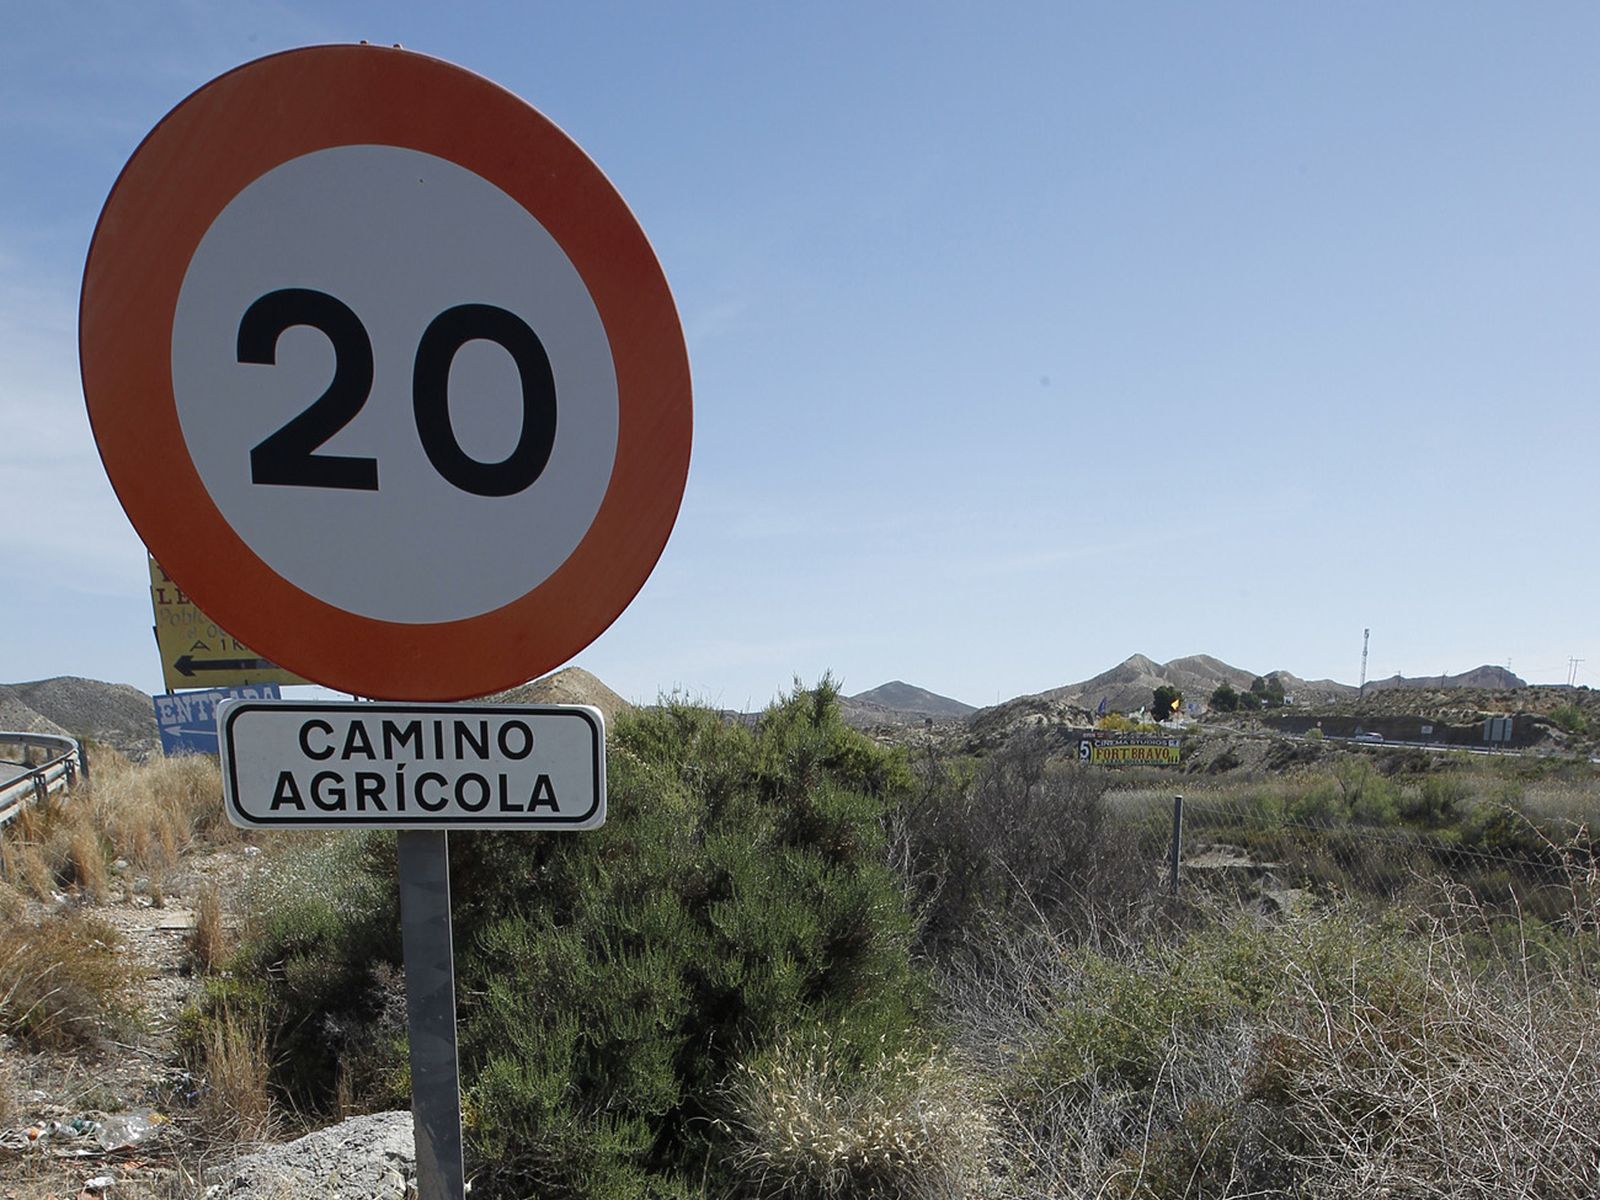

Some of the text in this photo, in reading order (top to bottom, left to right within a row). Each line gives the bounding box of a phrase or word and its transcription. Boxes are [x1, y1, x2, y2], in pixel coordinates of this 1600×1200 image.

[237, 287, 557, 497] 20
[156, 588, 191, 605] LE
[299, 719, 534, 761] CAMINO
[1080, 740, 1089, 759] 5
[1096, 747, 1169, 760] FORT BRAVO
[269, 763, 561, 813] AGRÍCOLA
